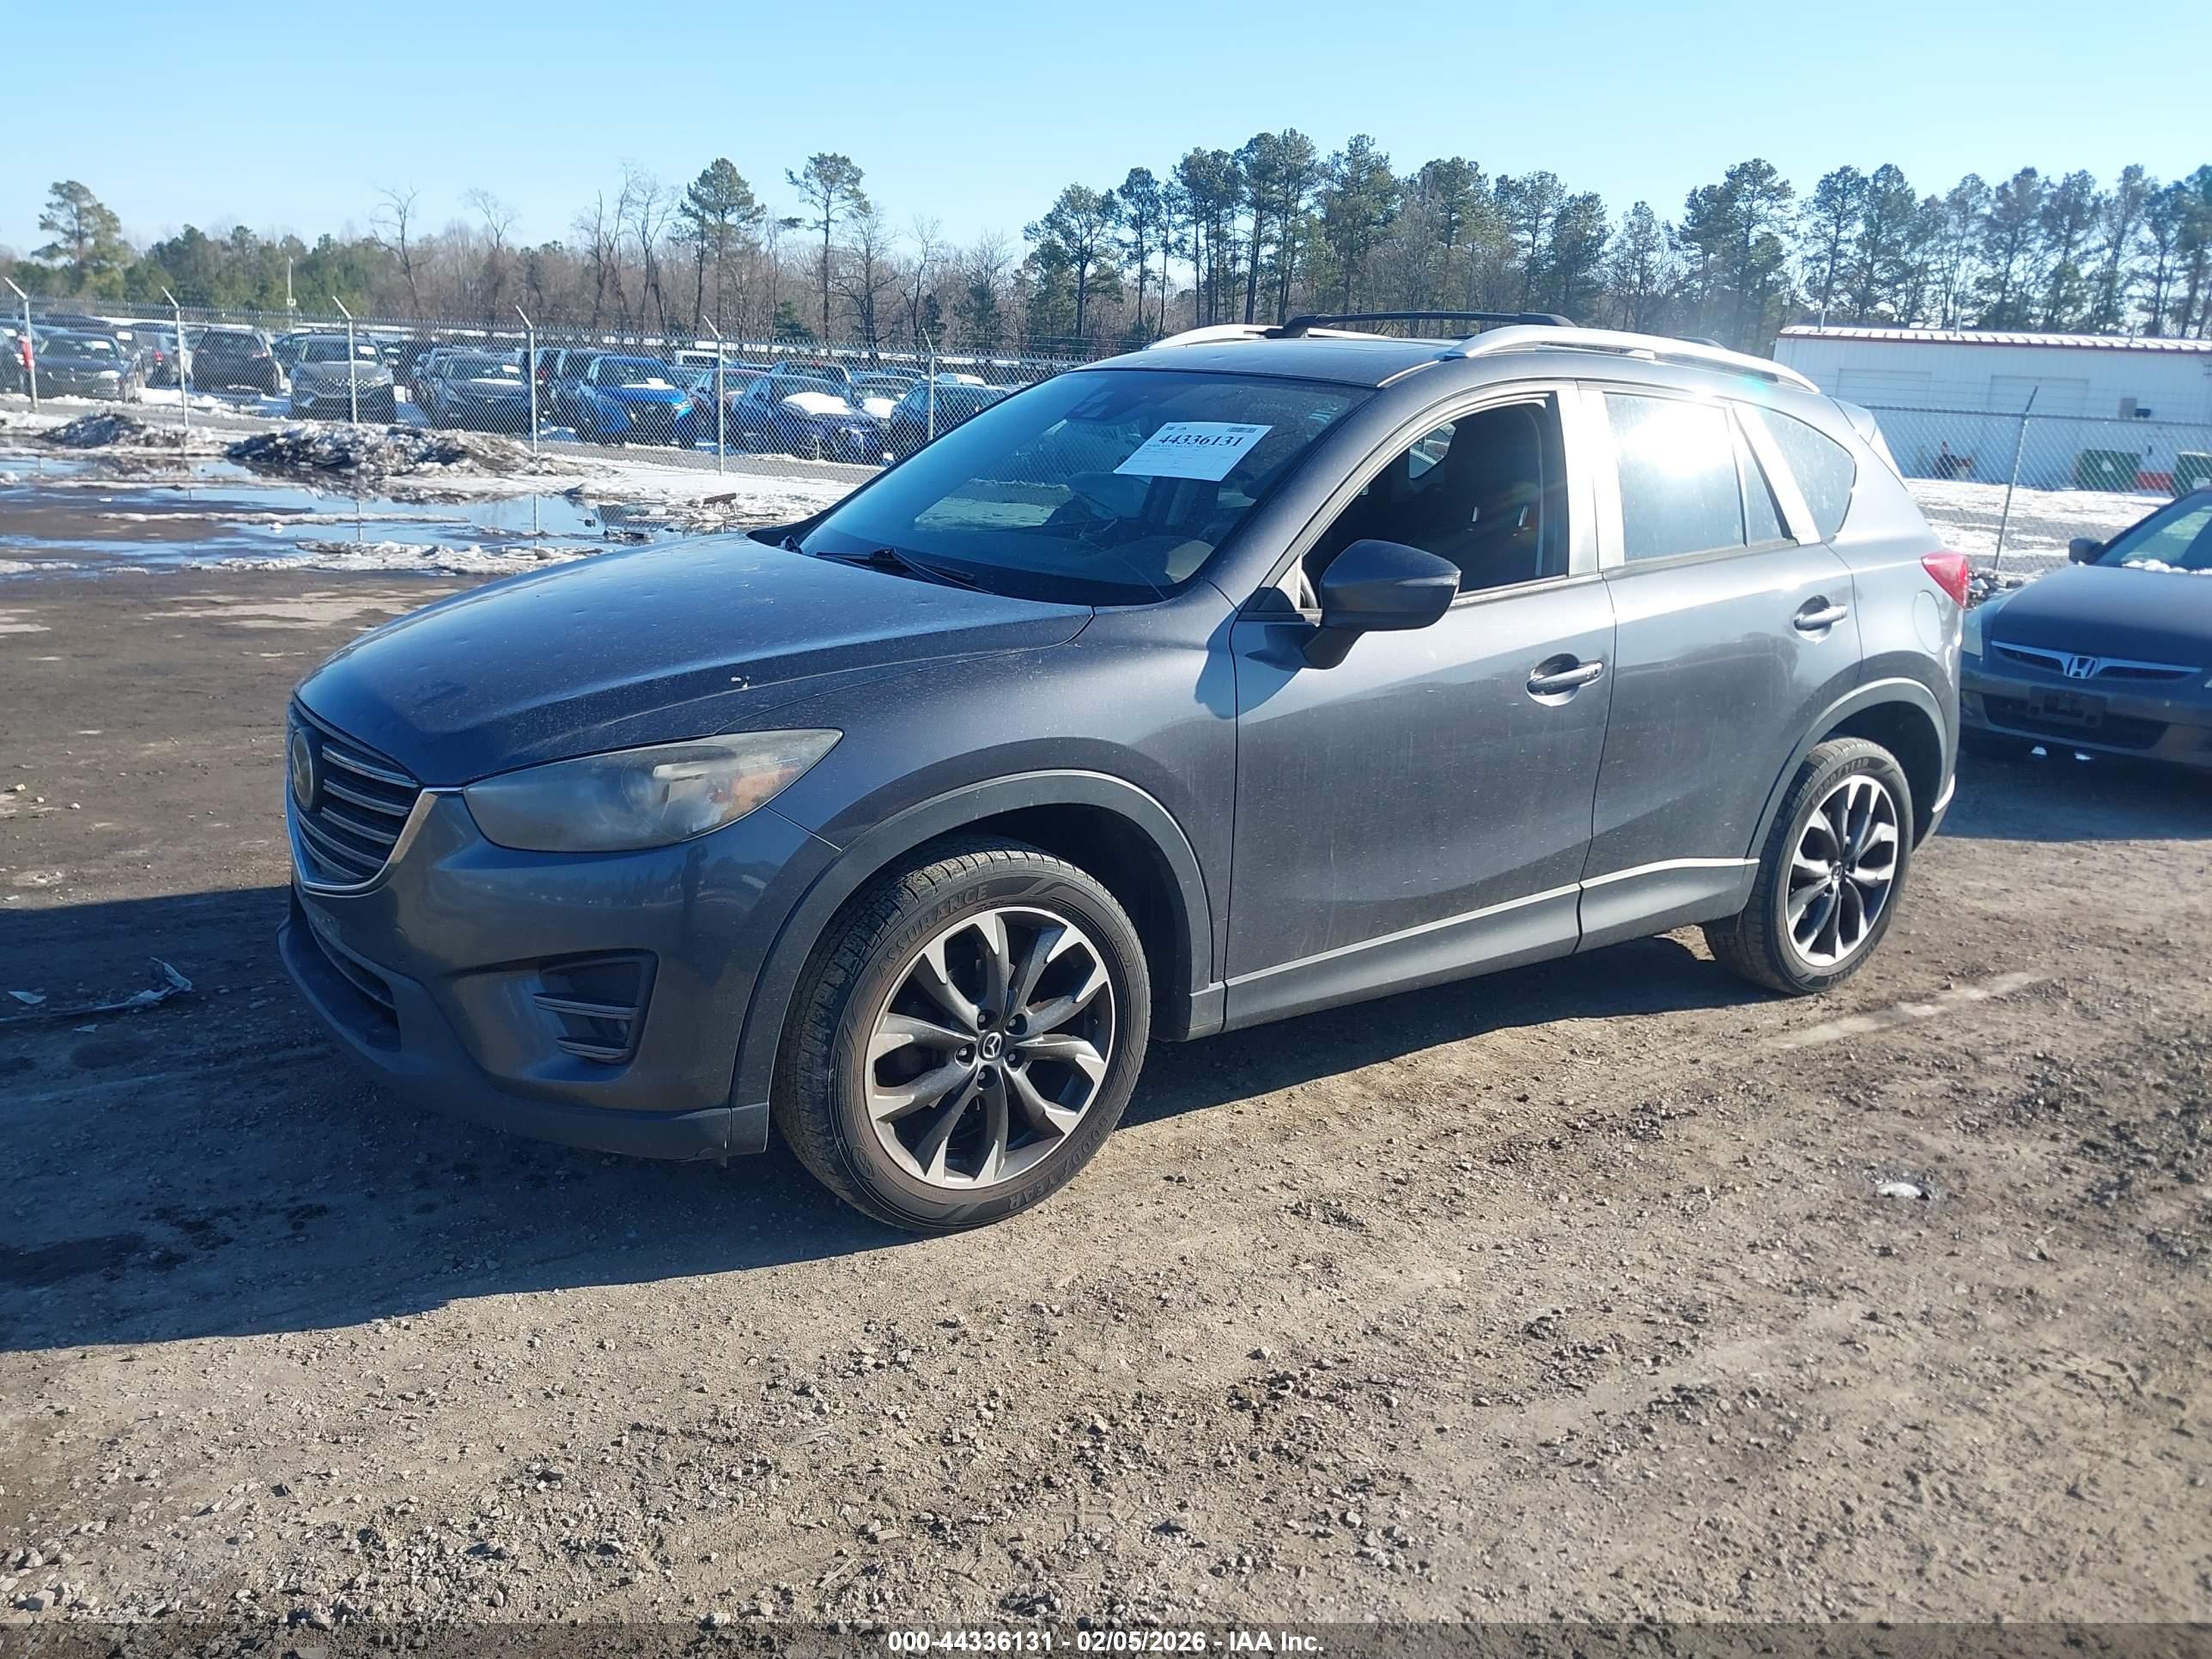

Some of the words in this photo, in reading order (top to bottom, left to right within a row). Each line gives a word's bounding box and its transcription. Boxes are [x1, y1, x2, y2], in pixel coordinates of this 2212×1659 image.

[1158, 433, 1244, 447] 44336131
[878, 884, 988, 980] ASSURANCE
[1007, 1115, 1109, 1211] GOODYEAR
